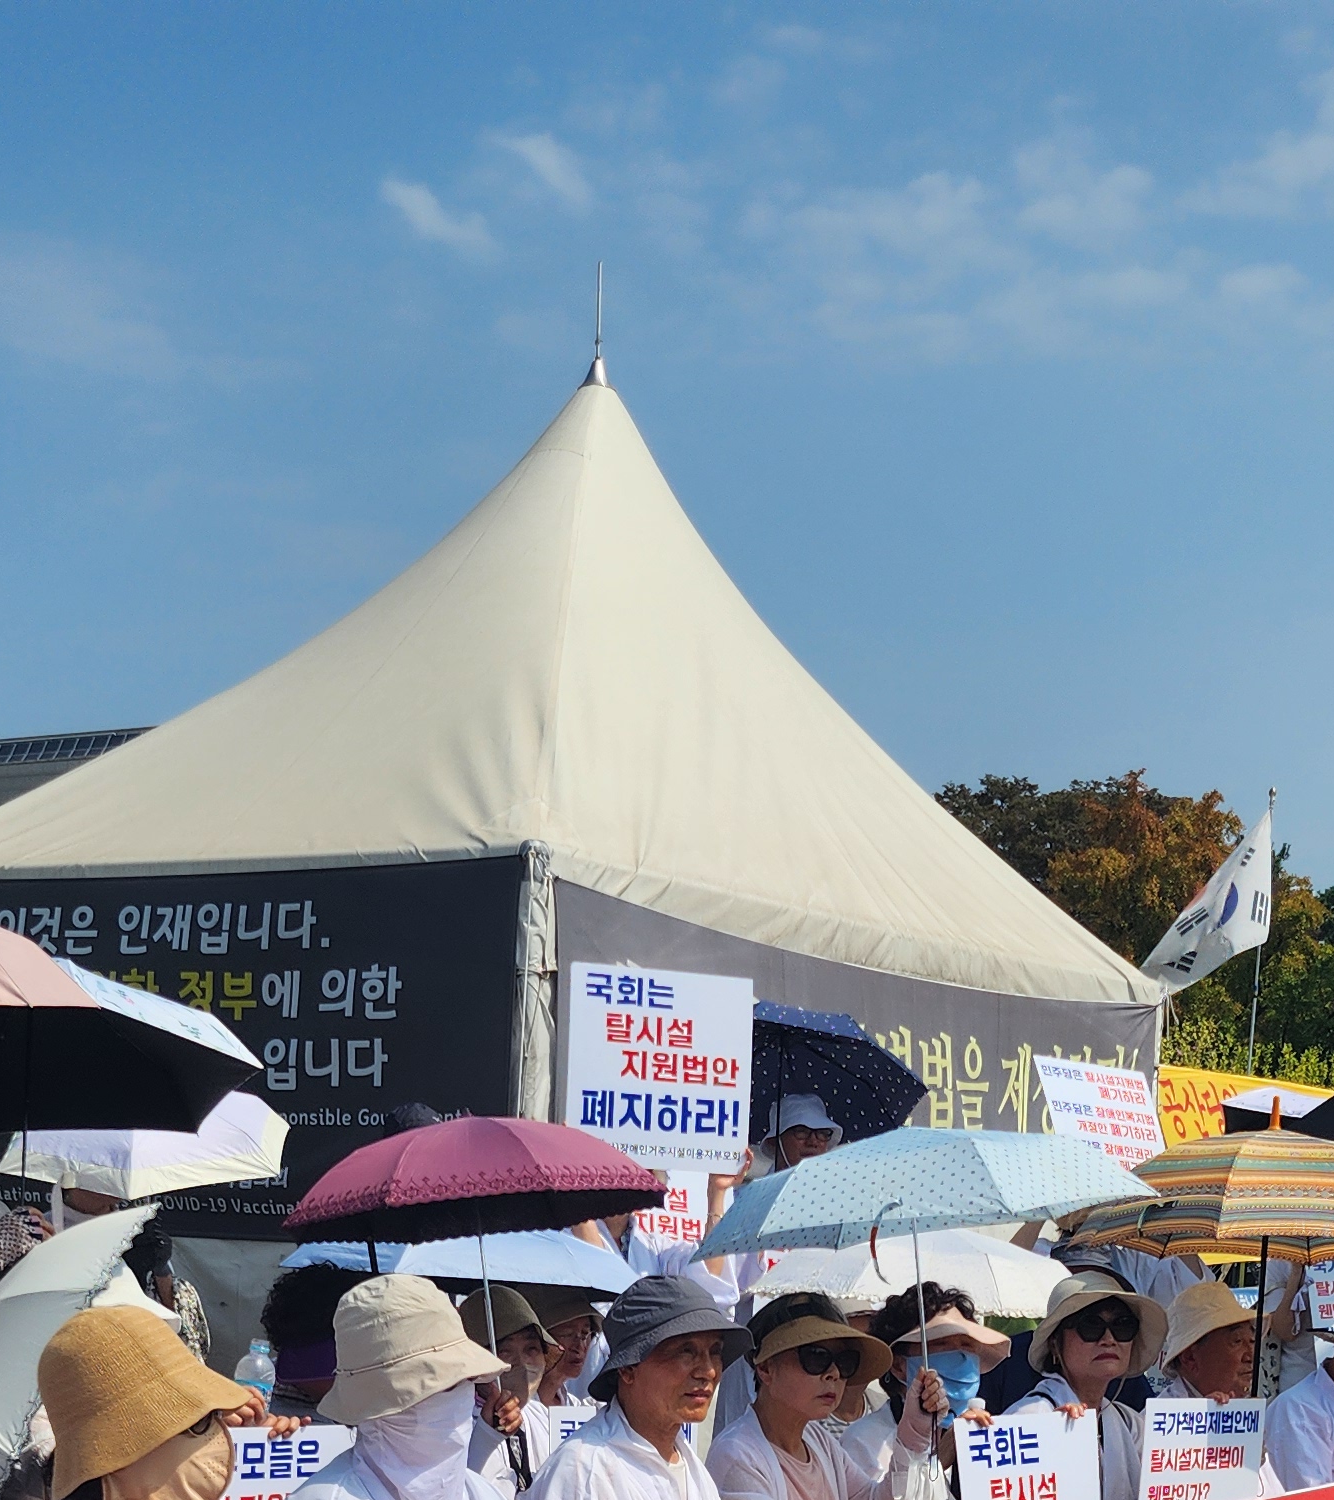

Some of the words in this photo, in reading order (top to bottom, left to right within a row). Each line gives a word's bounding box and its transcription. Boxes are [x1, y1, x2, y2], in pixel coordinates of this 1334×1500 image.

[118, 900, 331, 955] 인재입니다.
[318, 963, 403, 1020] 의한
[585, 972, 675, 1010] 국회는
[605, 1012, 693, 1049] 탈시설
[620, 1050, 740, 1088] 지원법안
[580, 1089, 741, 1138] 폐지하라!
[1152, 1410, 1260, 1436] 국가책임제법안에
[233, 1438, 320, 1480] 모들은
[968, 1426, 1040, 1468] 국회는
[1149, 1445, 1245, 1473] 탈시설지원법이
